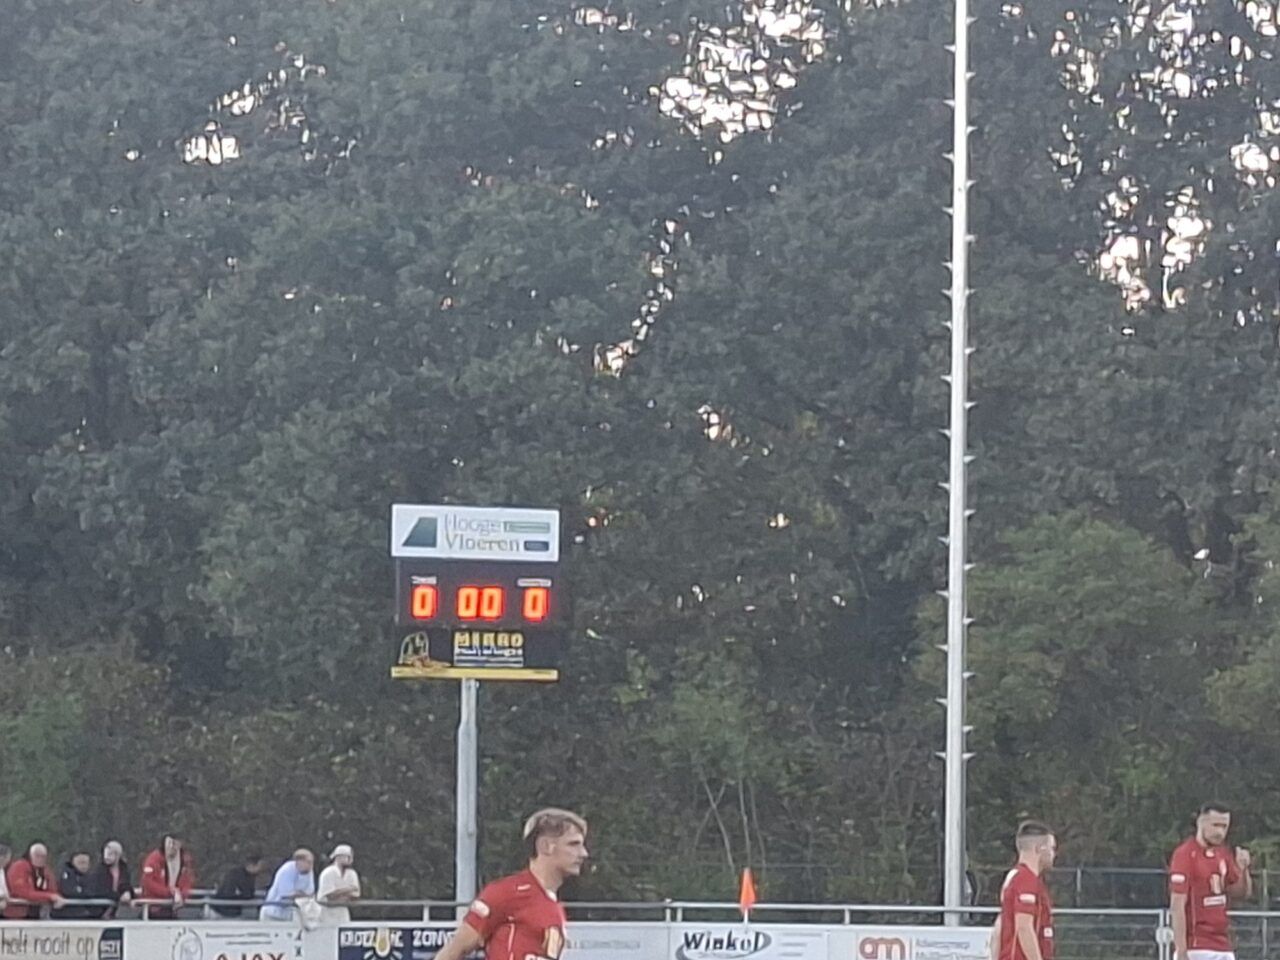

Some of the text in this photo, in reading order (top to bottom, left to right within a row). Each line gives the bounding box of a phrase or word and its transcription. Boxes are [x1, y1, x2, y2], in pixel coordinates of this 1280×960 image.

[412, 586, 436, 619] 0
[523, 588, 549, 621] 0
[684, 931, 760, 951] Winkel
